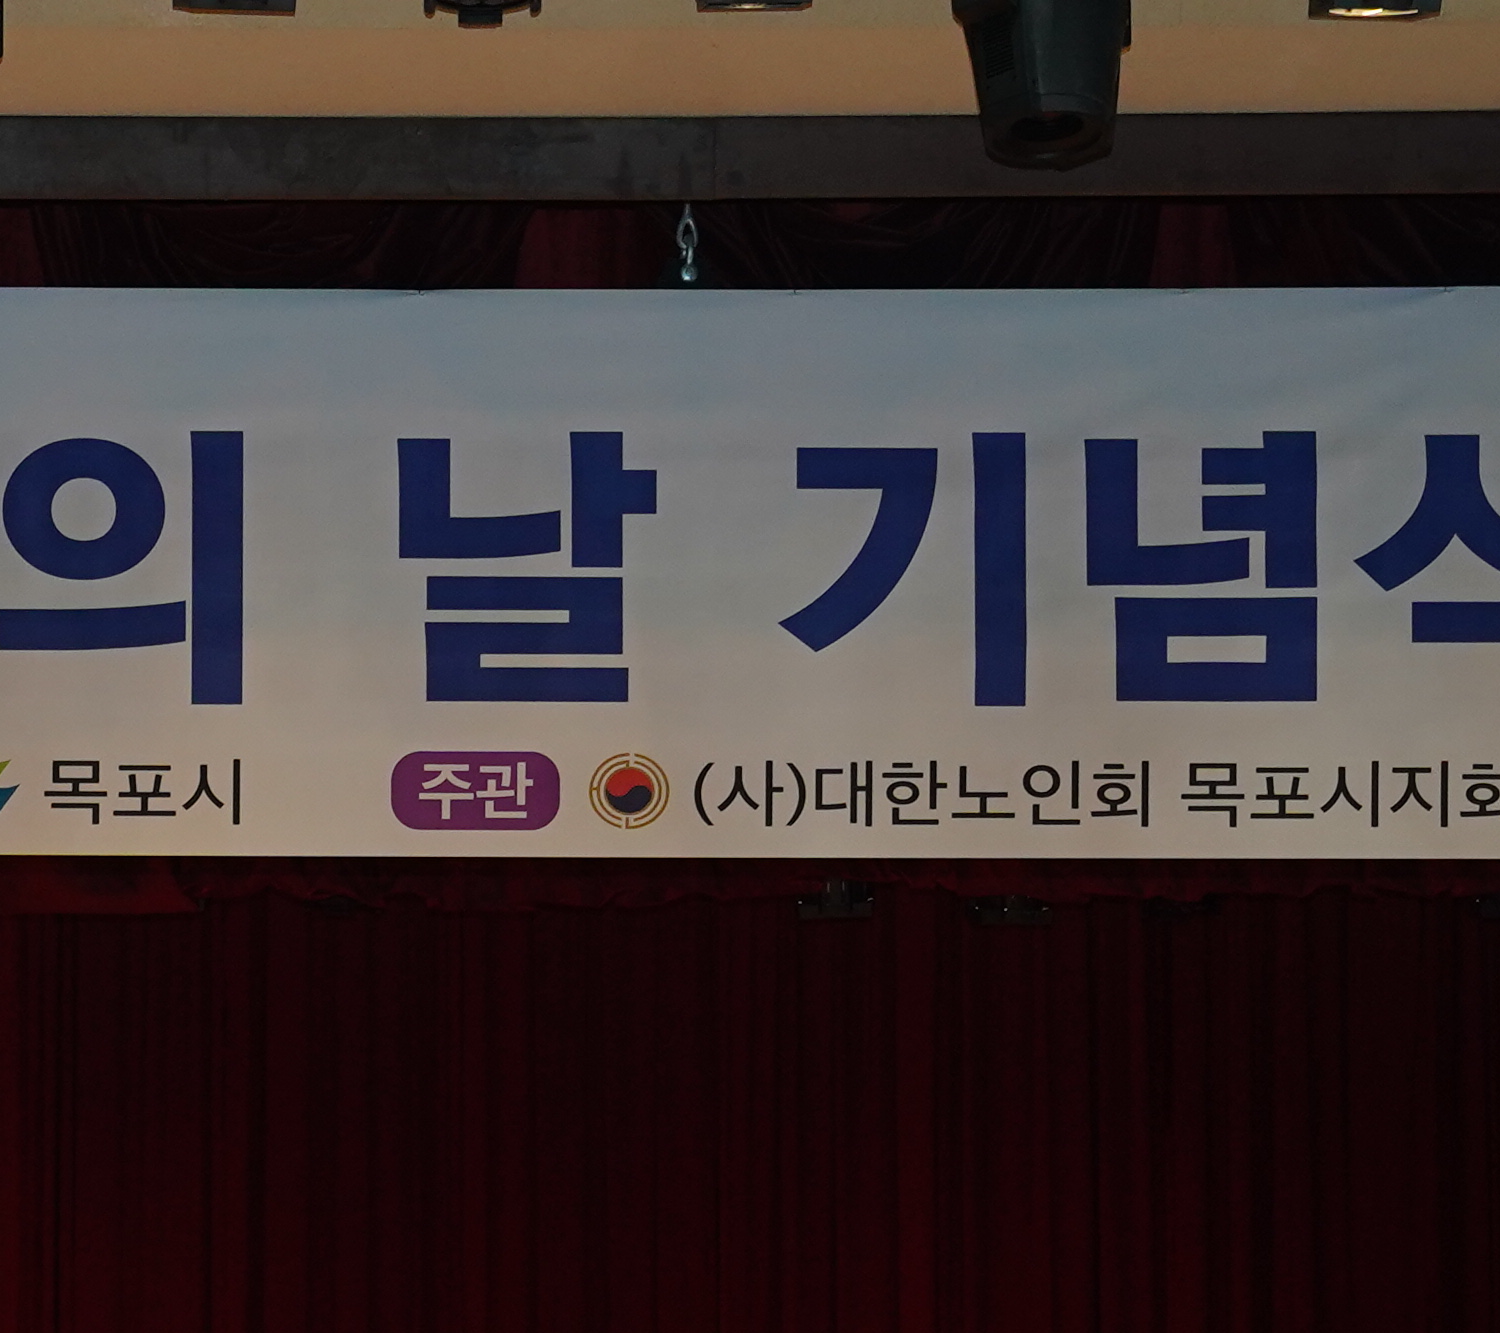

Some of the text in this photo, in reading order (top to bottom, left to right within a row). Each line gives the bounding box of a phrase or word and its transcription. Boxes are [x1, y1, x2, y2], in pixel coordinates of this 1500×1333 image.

[397, 432, 657, 702] 날
[44, 759, 240, 825] 목포시
[419, 762, 533, 819] 주관
[694, 761, 1149, 827] (사)대한노인회
